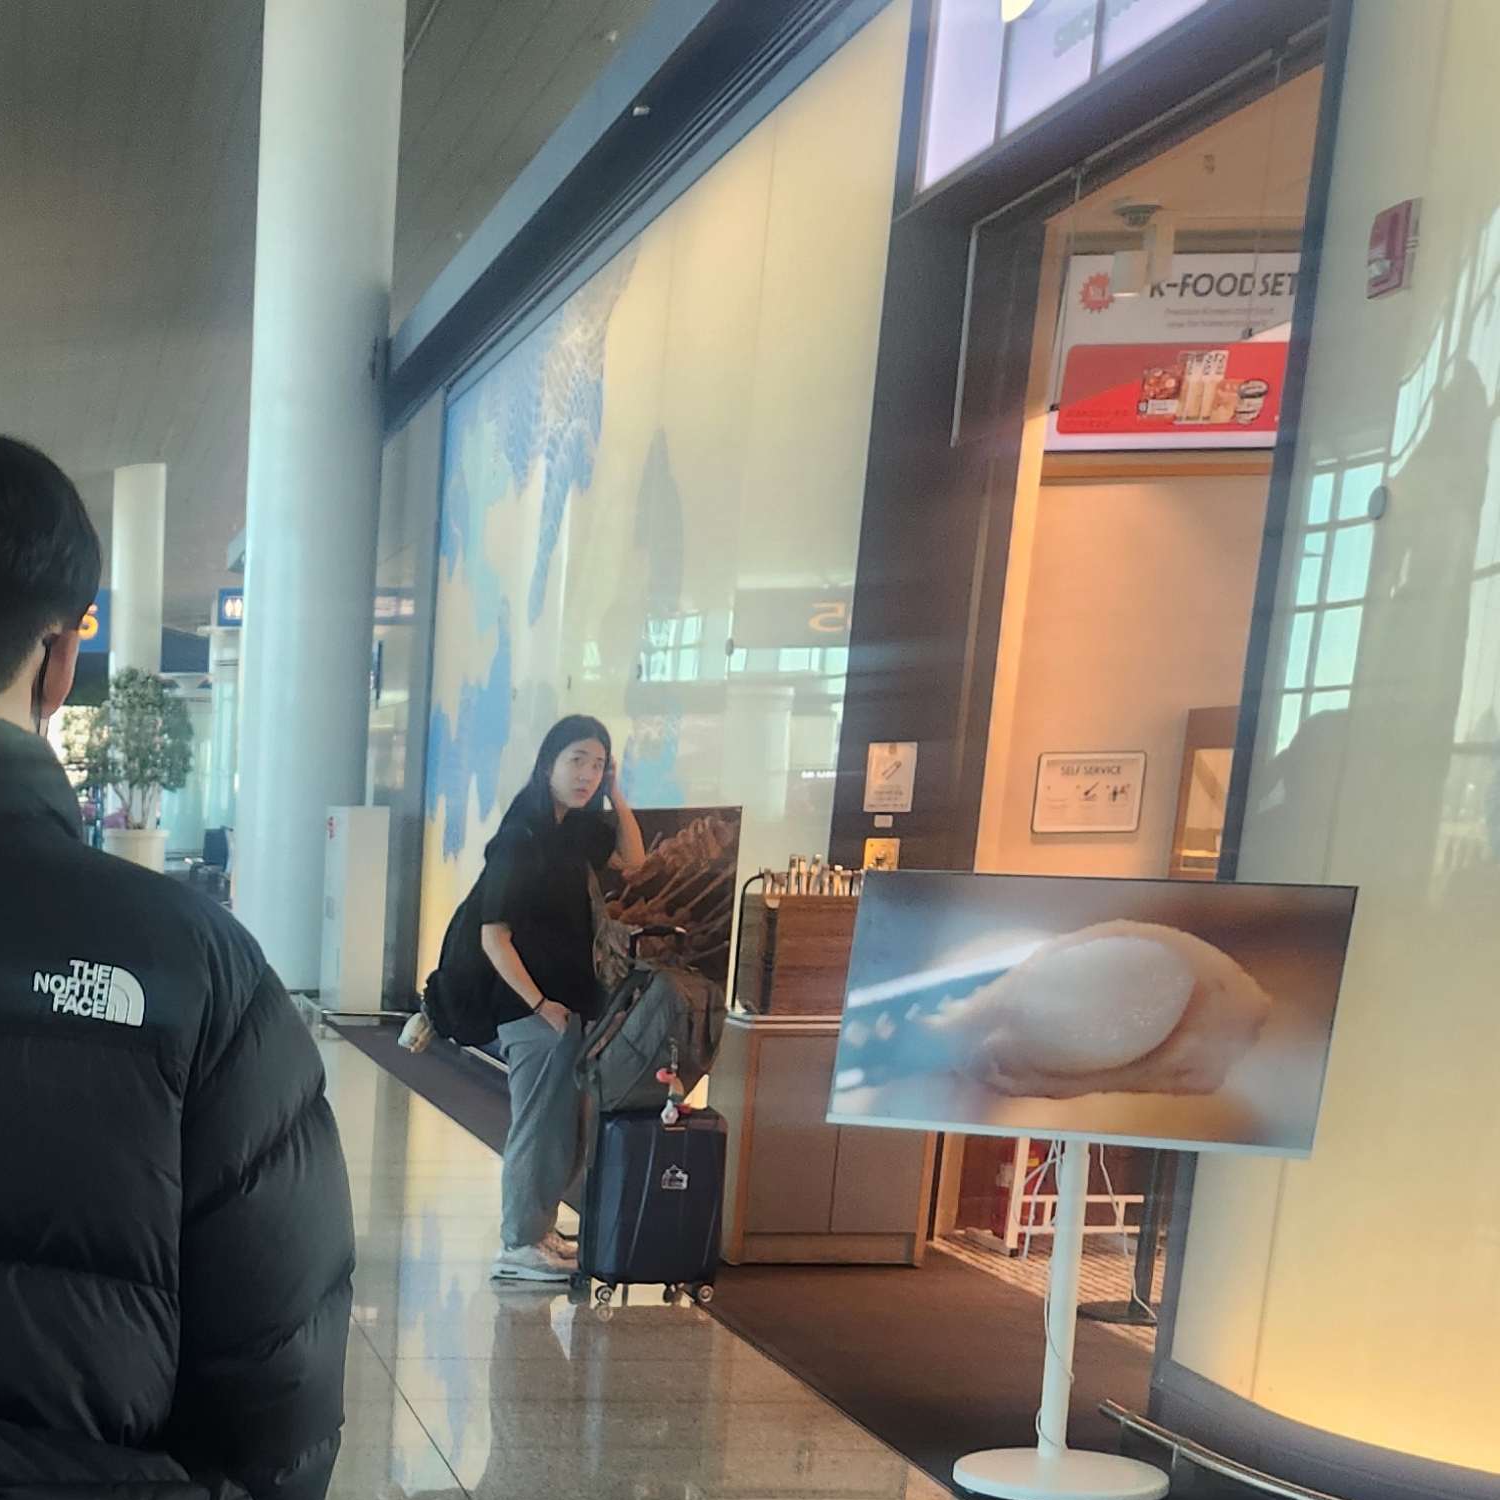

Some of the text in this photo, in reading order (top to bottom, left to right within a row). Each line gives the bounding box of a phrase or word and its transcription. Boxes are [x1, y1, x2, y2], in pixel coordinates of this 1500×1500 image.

[1084, 766, 1121, 775] SERVICE
[69, 959, 112, 981] THE
[33, 971, 110, 1004] NORTH
[52, 993, 106, 1020] FACE
